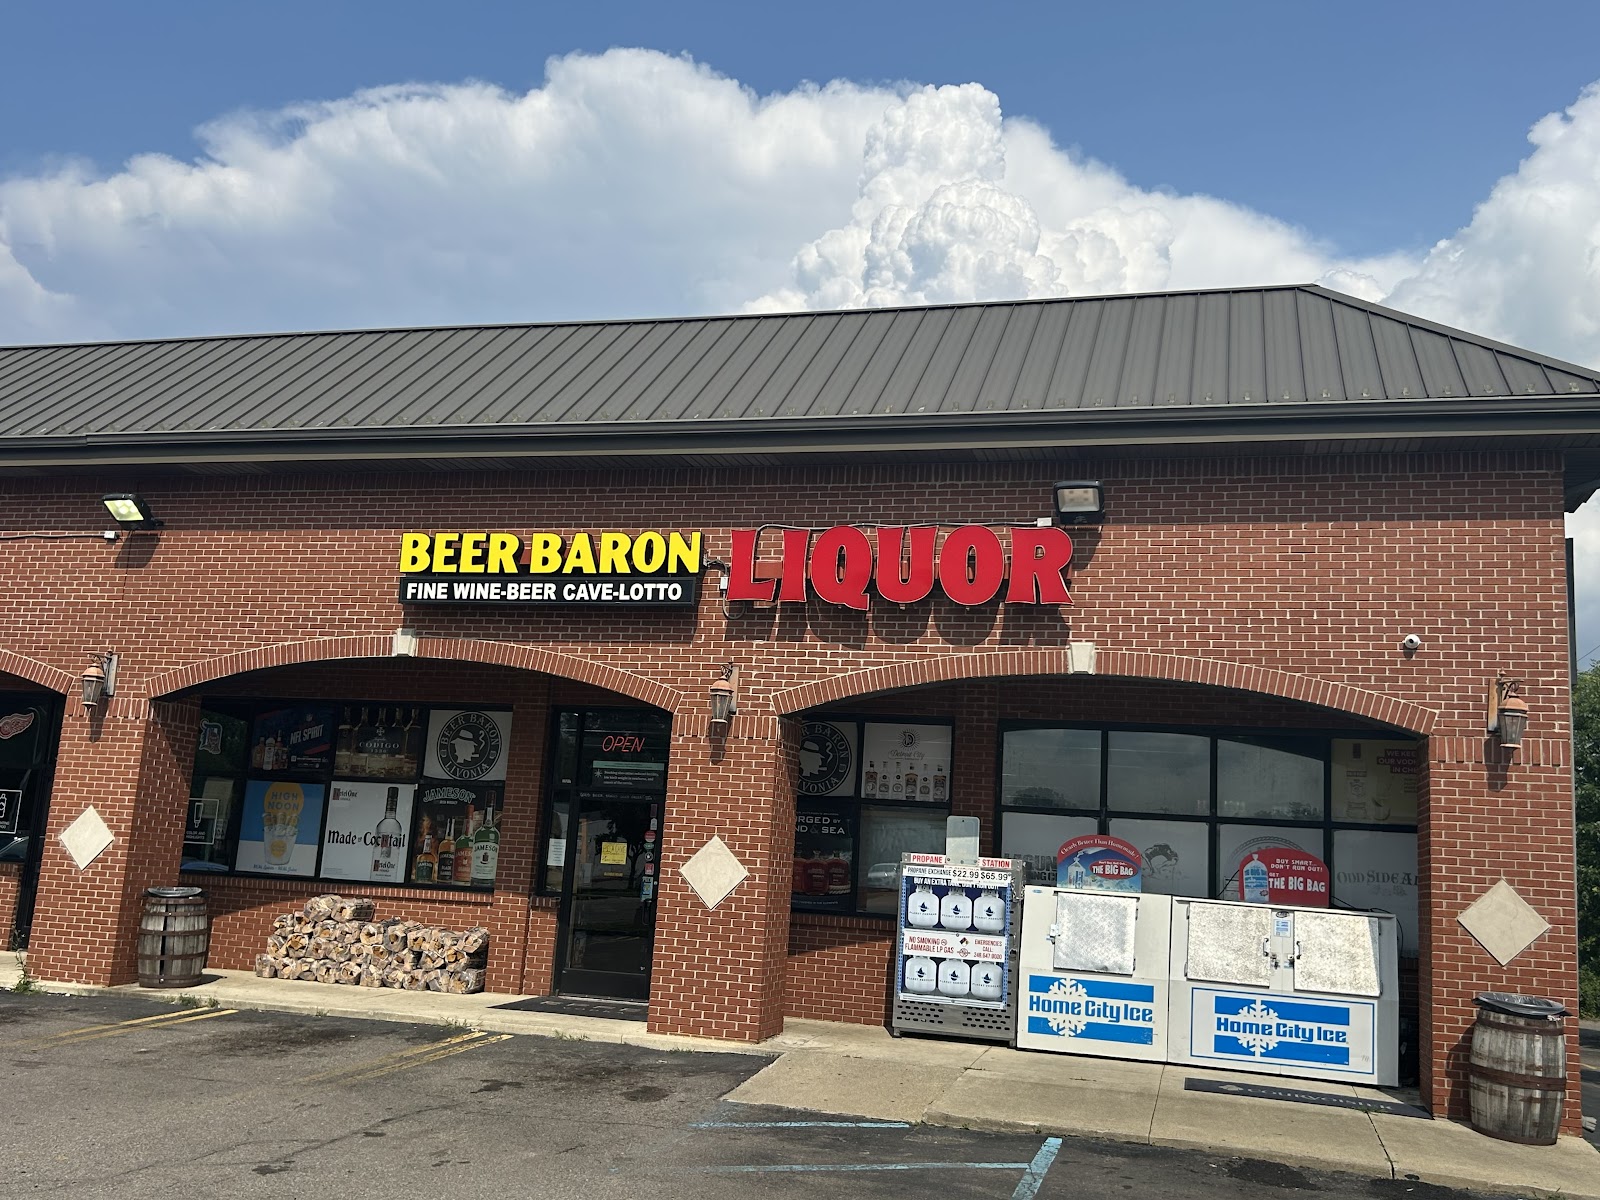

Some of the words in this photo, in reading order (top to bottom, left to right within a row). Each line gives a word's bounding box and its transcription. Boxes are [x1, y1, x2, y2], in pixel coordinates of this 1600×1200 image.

[400, 533, 520, 573] BEER
[530, 531, 701, 573] BARON
[726, 525, 1074, 610] LIQUOR
[407, 583, 448, 600] FINE
[453, 583, 556, 600] WINE-BEER
[563, 583, 682, 601] CAVE-LOTTO
[441, 716, 466, 745] BEER
[469, 714, 500, 745] BARON
[602, 735, 645, 753] OPEN
[815, 724, 848, 758] BARON
[445, 761, 490, 779] LIVONIA
[271, 792, 298, 800] HIGH
[423, 786, 477, 804] JAMESON
[267, 801, 300, 811] NOON
[327, 829, 356, 845] Made
[821, 826, 846, 835] SEA
[912, 854, 943, 864] PROPANE
[982, 859, 1010, 868] STATION
[907, 866, 928, 874] PROPANE
[928, 868, 951, 877] EXCHANGE
[952, 869, 979, 879] $22.99
[980, 871, 1008, 881] $65.99
[1092, 865, 1103, 874] THE
[1105, 864, 1118, 875] BIG
[1120, 865, 1133, 876] BAG
[1268, 877, 1285, 889] THE
[1288, 876, 1304, 891] BIG
[1307, 879, 1326, 893] BAG
[905, 943, 936, 953] FLAMMABLE
[944, 946, 954, 954] GAS
[917, 937, 940, 945] SMOKING
[974, 939, 1003, 947] EMERGENCIES
[1029, 995, 1081, 1016] Home
[1085, 1000, 1120, 1023] City
[1124, 1004, 1153, 1022] Ice
[1216, 1017, 1272, 1036] Home
[1276, 1022, 1313, 1042] City
[1317, 1027, 1347, 1043] Ice
